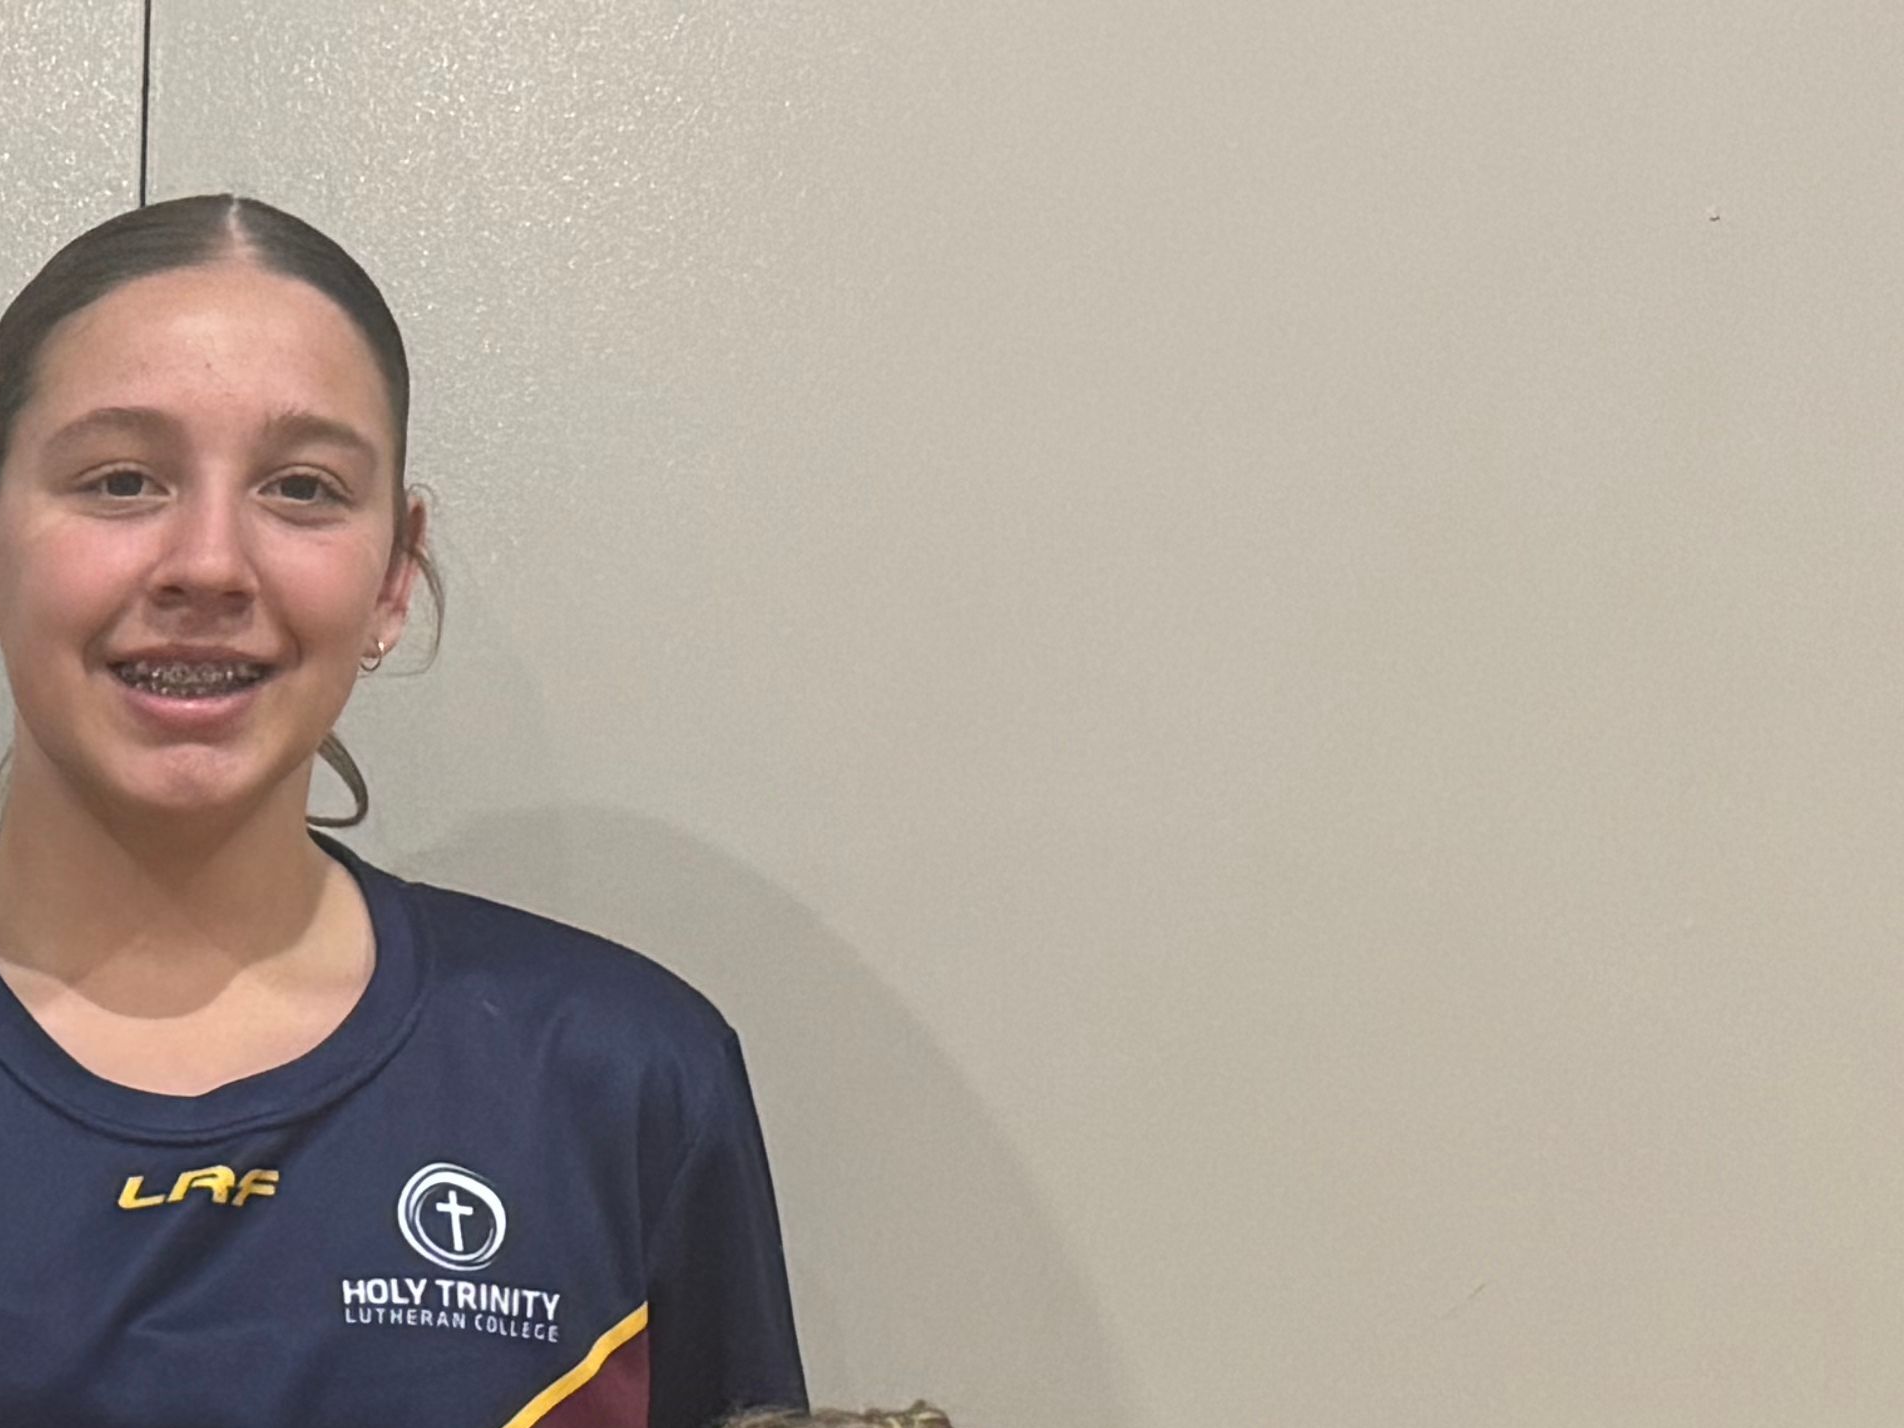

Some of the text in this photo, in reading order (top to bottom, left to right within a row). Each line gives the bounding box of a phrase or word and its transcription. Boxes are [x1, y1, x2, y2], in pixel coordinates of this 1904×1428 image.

[117, 1164, 280, 1209] LRF
[341, 1277, 561, 1321] HOLY TRINITY
[344, 1306, 560, 1344] LUTHERAN COLLEGE
